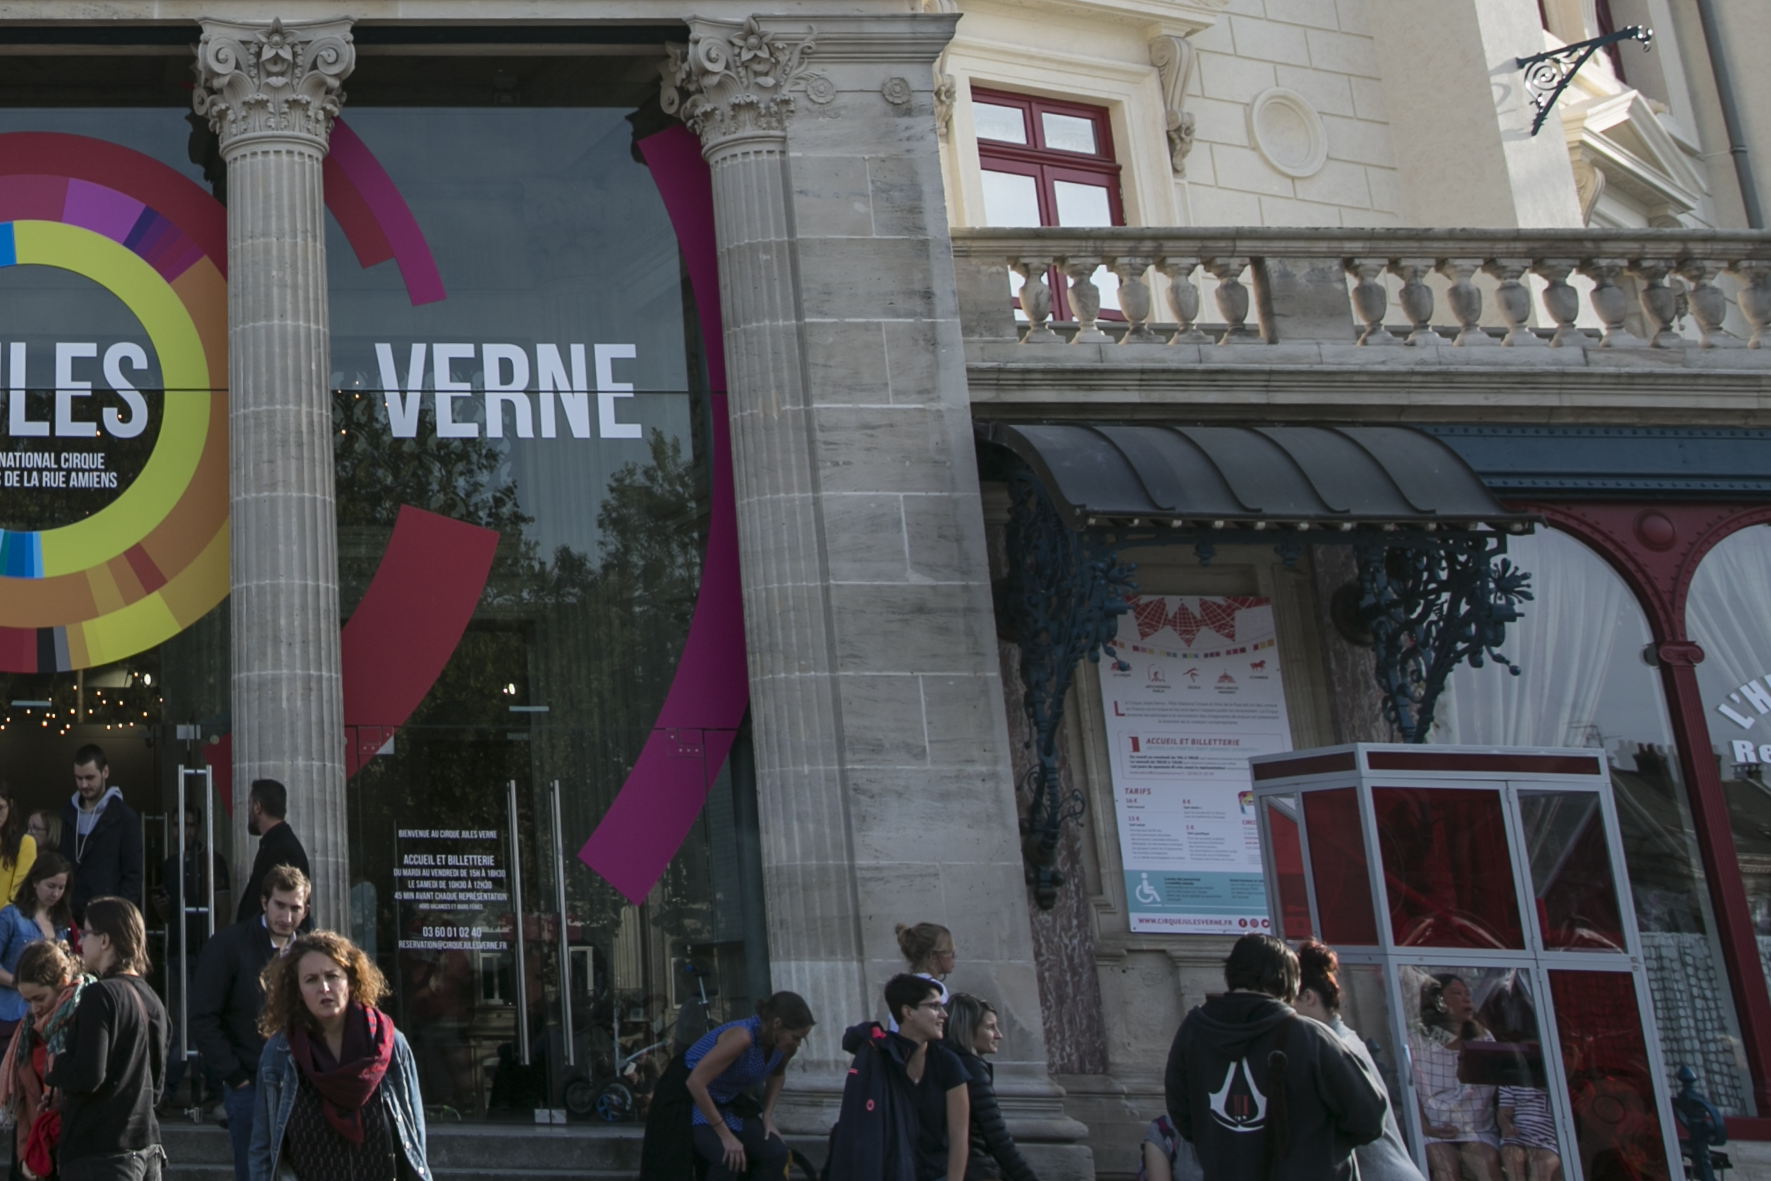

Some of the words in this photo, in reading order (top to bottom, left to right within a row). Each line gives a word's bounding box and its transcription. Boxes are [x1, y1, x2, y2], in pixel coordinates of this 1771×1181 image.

[375, 343, 642, 438] VERNE
[60, 453, 105, 469] CIRQUE
[4, 471, 20, 487] DE
[23, 471, 39, 487] LA
[42, 471, 66, 488] RUE
[69, 472, 118, 488] AMIENS
[1179, 738, 1189, 746] ET
[1191, 738, 1240, 746] BILLETTERIE
[1124, 787, 1152, 795] TARIFS
[398, 830, 430, 838] BIENVENUE
[430, 830, 439, 838] AU
[439, 830, 460, 838] CIRQUE
[461, 830, 478, 839] JULES
[478, 830, 497, 839] VERNE
[403, 854, 435, 865] ACCUEIL
[436, 854, 446, 865] ET
[448, 855, 495, 866] BILLETTERIE
[393, 868, 402, 877] DU
[402, 868, 421, 877] MARDI
[422, 868, 430, 877] AU
[430, 868, 459, 877] VENDREDI
[460, 869, 468, 877] DE
[469, 869, 480, 877] 15H
[481, 868, 486, 878] À
[487, 869, 506, 878] 18H30
[408, 880, 415, 888] LE
[416, 880, 438, 889] SAMEDI
[439, 880, 447, 889] DE
[448, 880, 467, 889] 10H30
[467, 879, 473, 889] À
[473, 881, 493, 889] 12H30
[394, 891, 402, 900] 45
[403, 891, 415, 900] MIN
[415, 892, 434, 900] AVANT
[434, 892, 458, 900] CHAQUE
[458, 891, 508, 901] REPRÉSENTATION
[1137, 917, 1233, 926] WWW.CIRQUEJULESVERNE.FR
[422, 926, 433, 938] 03
[434, 926, 446, 938] 60
[446, 926, 457, 938] 01
[459, 926, 470, 938] 02
[471, 926, 482, 938] 40
[398, 940, 507, 950] RESERVATION@CIRQUEJULESVERNE.FR
